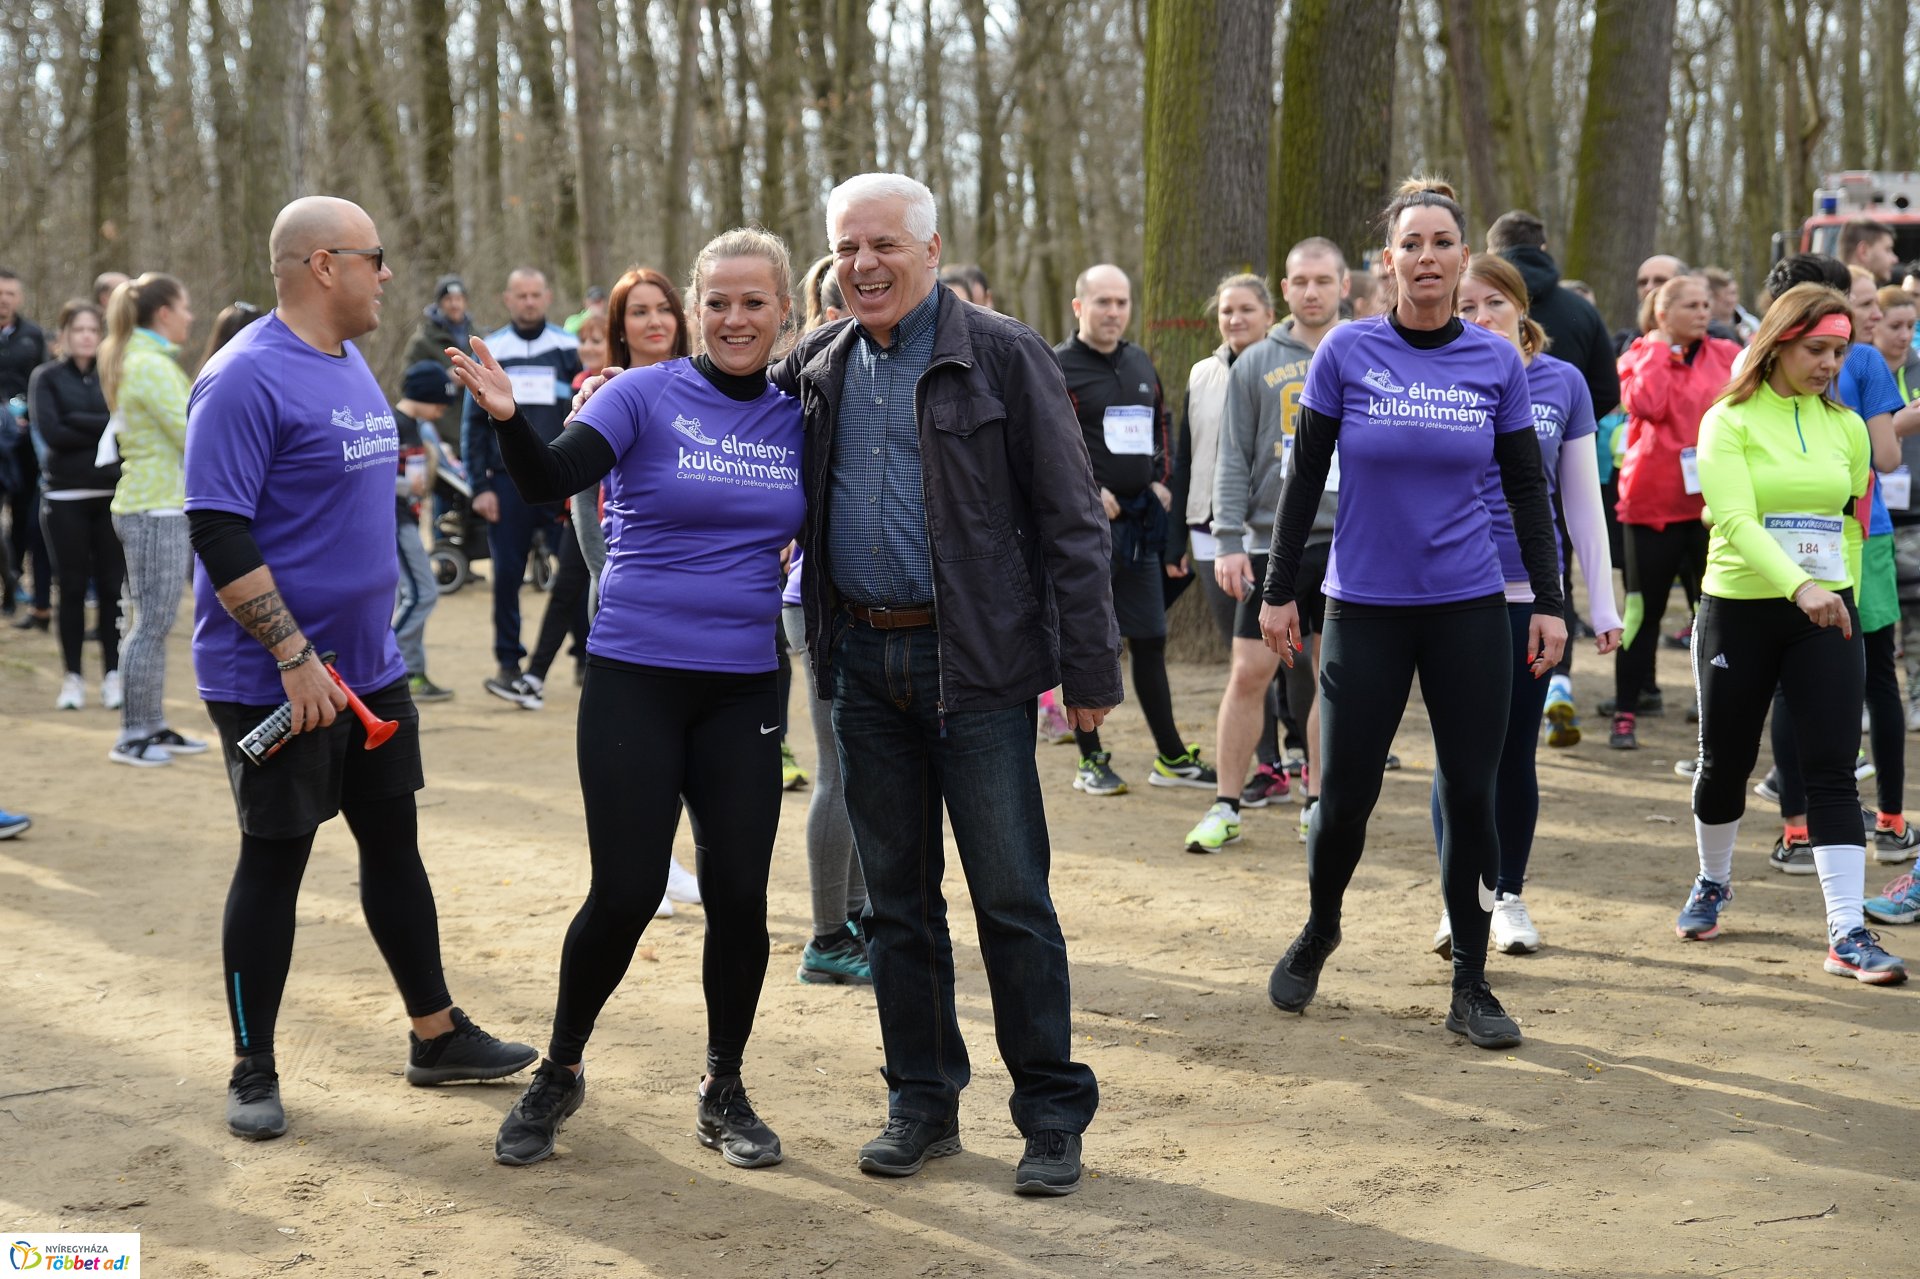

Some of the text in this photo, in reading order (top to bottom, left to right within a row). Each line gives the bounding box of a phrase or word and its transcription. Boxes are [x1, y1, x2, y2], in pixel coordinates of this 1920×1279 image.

[1408, 382, 1487, 408] élmény-
[365, 410, 398, 433] élmén
[1368, 396, 1487, 428] különítmény
[342, 431, 399, 462] különítmé
[721, 434, 796, 464] élmény-
[676, 471, 706, 482] Csinálj
[678, 447, 799, 486] különítmény
[1797, 543, 1818, 554] 184
